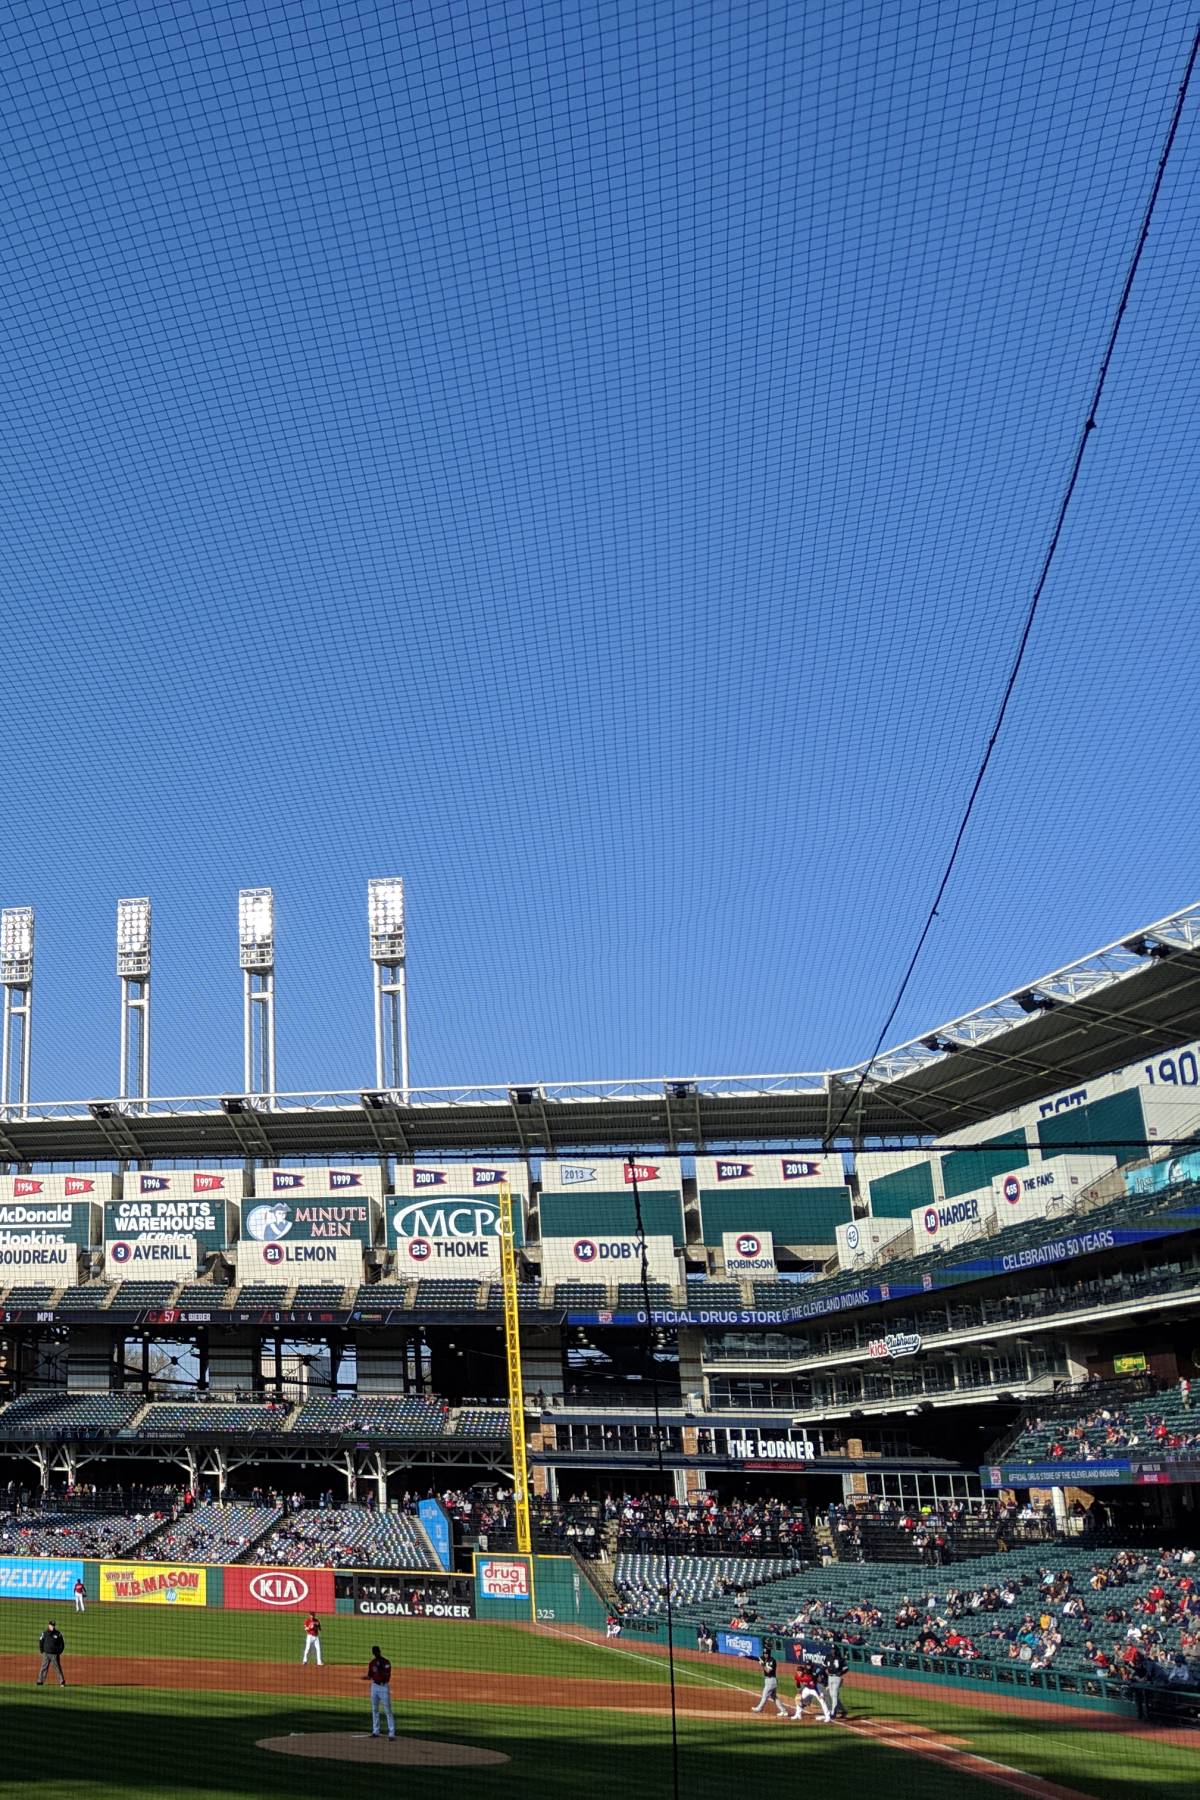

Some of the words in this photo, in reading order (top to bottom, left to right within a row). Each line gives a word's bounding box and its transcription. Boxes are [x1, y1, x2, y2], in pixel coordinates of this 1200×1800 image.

[1145, 1050, 1200, 1085] 190
[564, 1170, 584, 1180] 2013
[628, 1168, 648, 1178] 2016
[721, 1165, 742, 1176] 2017
[786, 1164, 808, 1174] 2018
[276, 1175, 294, 1186] 1998
[332, 1174, 351, 1185] 1999
[416, 1173, 435, 1183] 2001
[476, 1172, 495, 1181] 2007
[17, 1182, 33, 1192] 1954
[68, 1181, 84, 1191] 1995
[143, 1178, 160, 1189] 1996
[196, 1178, 213, 1188] 1997
[1006, 1184, 1018, 1195] 455
[1023, 1178, 1036, 1191] THE
[1036, 1172, 1054, 1187] FANS
[119, 1203, 154, 1217] CAR
[157, 1202, 210, 1216] PARTS
[295, 1207, 367, 1222] MINUTE
[926, 1215, 935, 1228] 18
[938, 1199, 979, 1227] HARDER
[115, 1217, 215, 1232] WAREHOUSE
[310, 1223, 351, 1237] MEN
[412, 1244, 428, 1255] 25
[434, 1242, 489, 1257] THOME
[578, 1245, 593, 1257] 14
[599, 1243, 642, 1259] DOBY
[739, 1240, 757, 1252] 20
[1002, 1243, 1066, 1271] CELEBRATING
[1066, 1238, 1079, 1255] 50
[1079, 1230, 1115, 1252] YEARS
[117, 1248, 125, 1258] 3
[133, 1245, 191, 1260] AVERILL
[267, 1249, 279, 1259] 21
[285, 1246, 337, 1262] LEMON
[727, 1258, 773, 1270] ROBINSON
[700, 1311, 737, 1323] DRUG
[741, 1311, 782, 1323] STORE
[782, 1308, 791, 1321] OF
[791, 1306, 803, 1320] THE
[803, 1296, 841, 1316] CLEVELAND
[841, 1290, 870, 1308] INDIANS
[37, 1312, 53, 1321] MPH
[164, 1311, 174, 1321] 57
[731, 1440, 755, 1458] THE
[758, 1440, 815, 1460] CORNER
[484, 1562, 520, 1583] drug
[260, 1579, 299, 1598] KIA
[488, 1582, 528, 1594] mart
[360, 1602, 412, 1616] GLOBAL
[425, 1604, 470, 1617] POKER
[537, 1609, 555, 1619] 325
